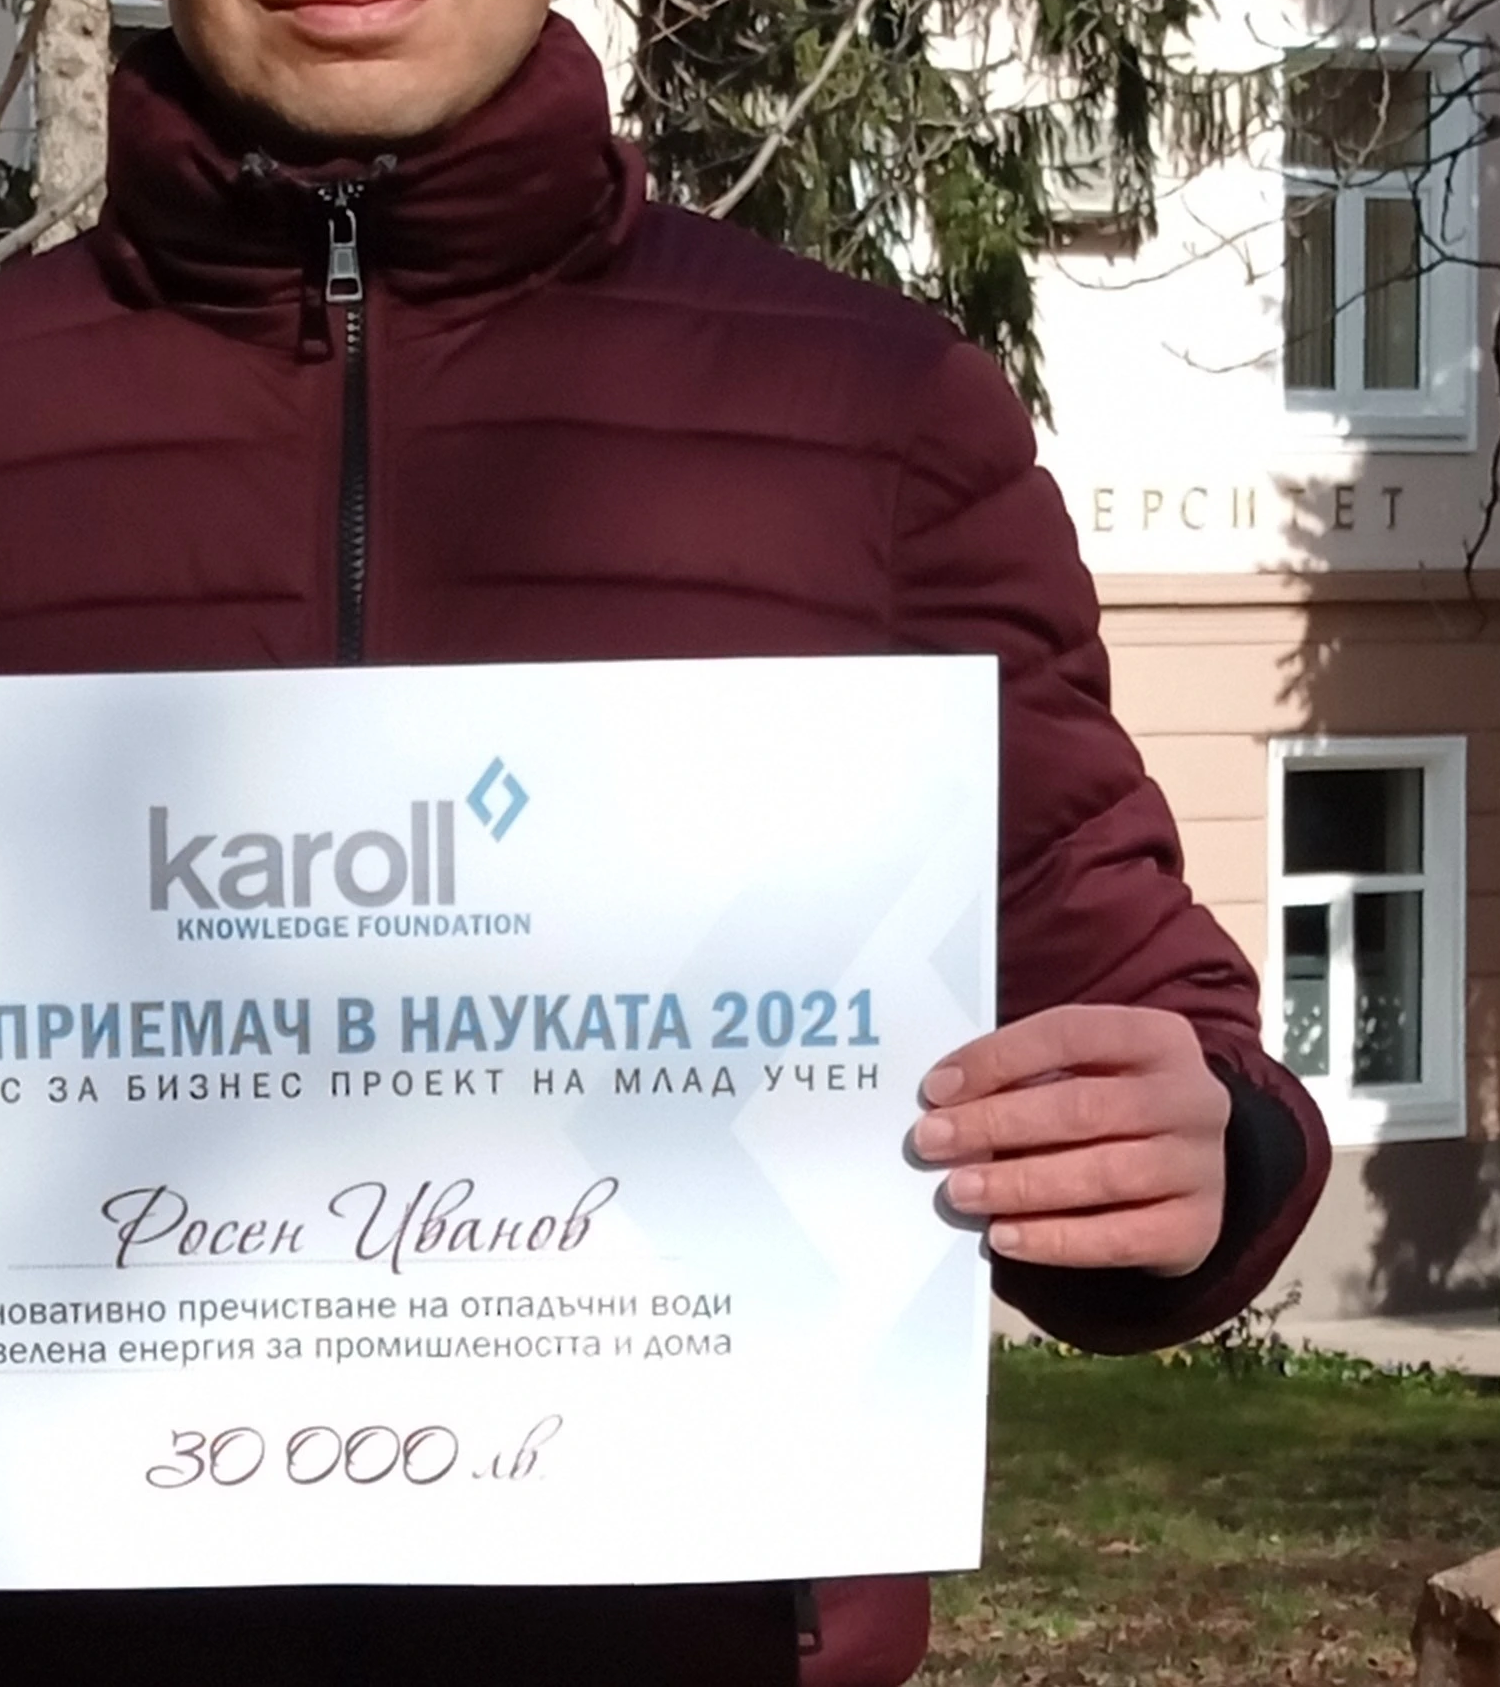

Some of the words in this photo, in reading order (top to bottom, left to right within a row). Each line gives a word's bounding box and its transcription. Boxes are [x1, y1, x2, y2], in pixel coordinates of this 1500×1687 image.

[1092, 483, 1403, 532] ЕРСИТЕТ
[149, 800, 456, 912] karoll
[177, 915, 350, 942] KNOWLEDGE
[357, 913, 532, 939] FOUNDATION
[336, 996, 377, 1055] В
[401, 992, 692, 1054] НАУКАТА
[710, 988, 881, 1049] 2021
[47, 1075, 99, 1104] ЗА
[127, 1071, 303, 1102] БИЗНЕС
[331, 1067, 504, 1097] ПРОЕКТ
[533, 1067, 585, 1095] НА
[614, 1064, 736, 1098] МЛАД
[763, 1062, 879, 1092] УЧЕН
[327, 1176, 620, 1275] Иванов
[178, 1295, 397, 1328] пречистване
[408, 1296, 449, 1319] на
[460, 1294, 638, 1321] отпадъчни
[651, 1292, 733, 1319] води
[118, 1337, 255, 1368] енергия
[265, 1337, 303, 1360] за
[314, 1334, 602, 1364] промишлеността
[614, 1334, 633, 1357] и
[643, 1332, 733, 1360] дома
[145, 1425, 266, 1490] 30
[286, 1424, 460, 1486] 000
